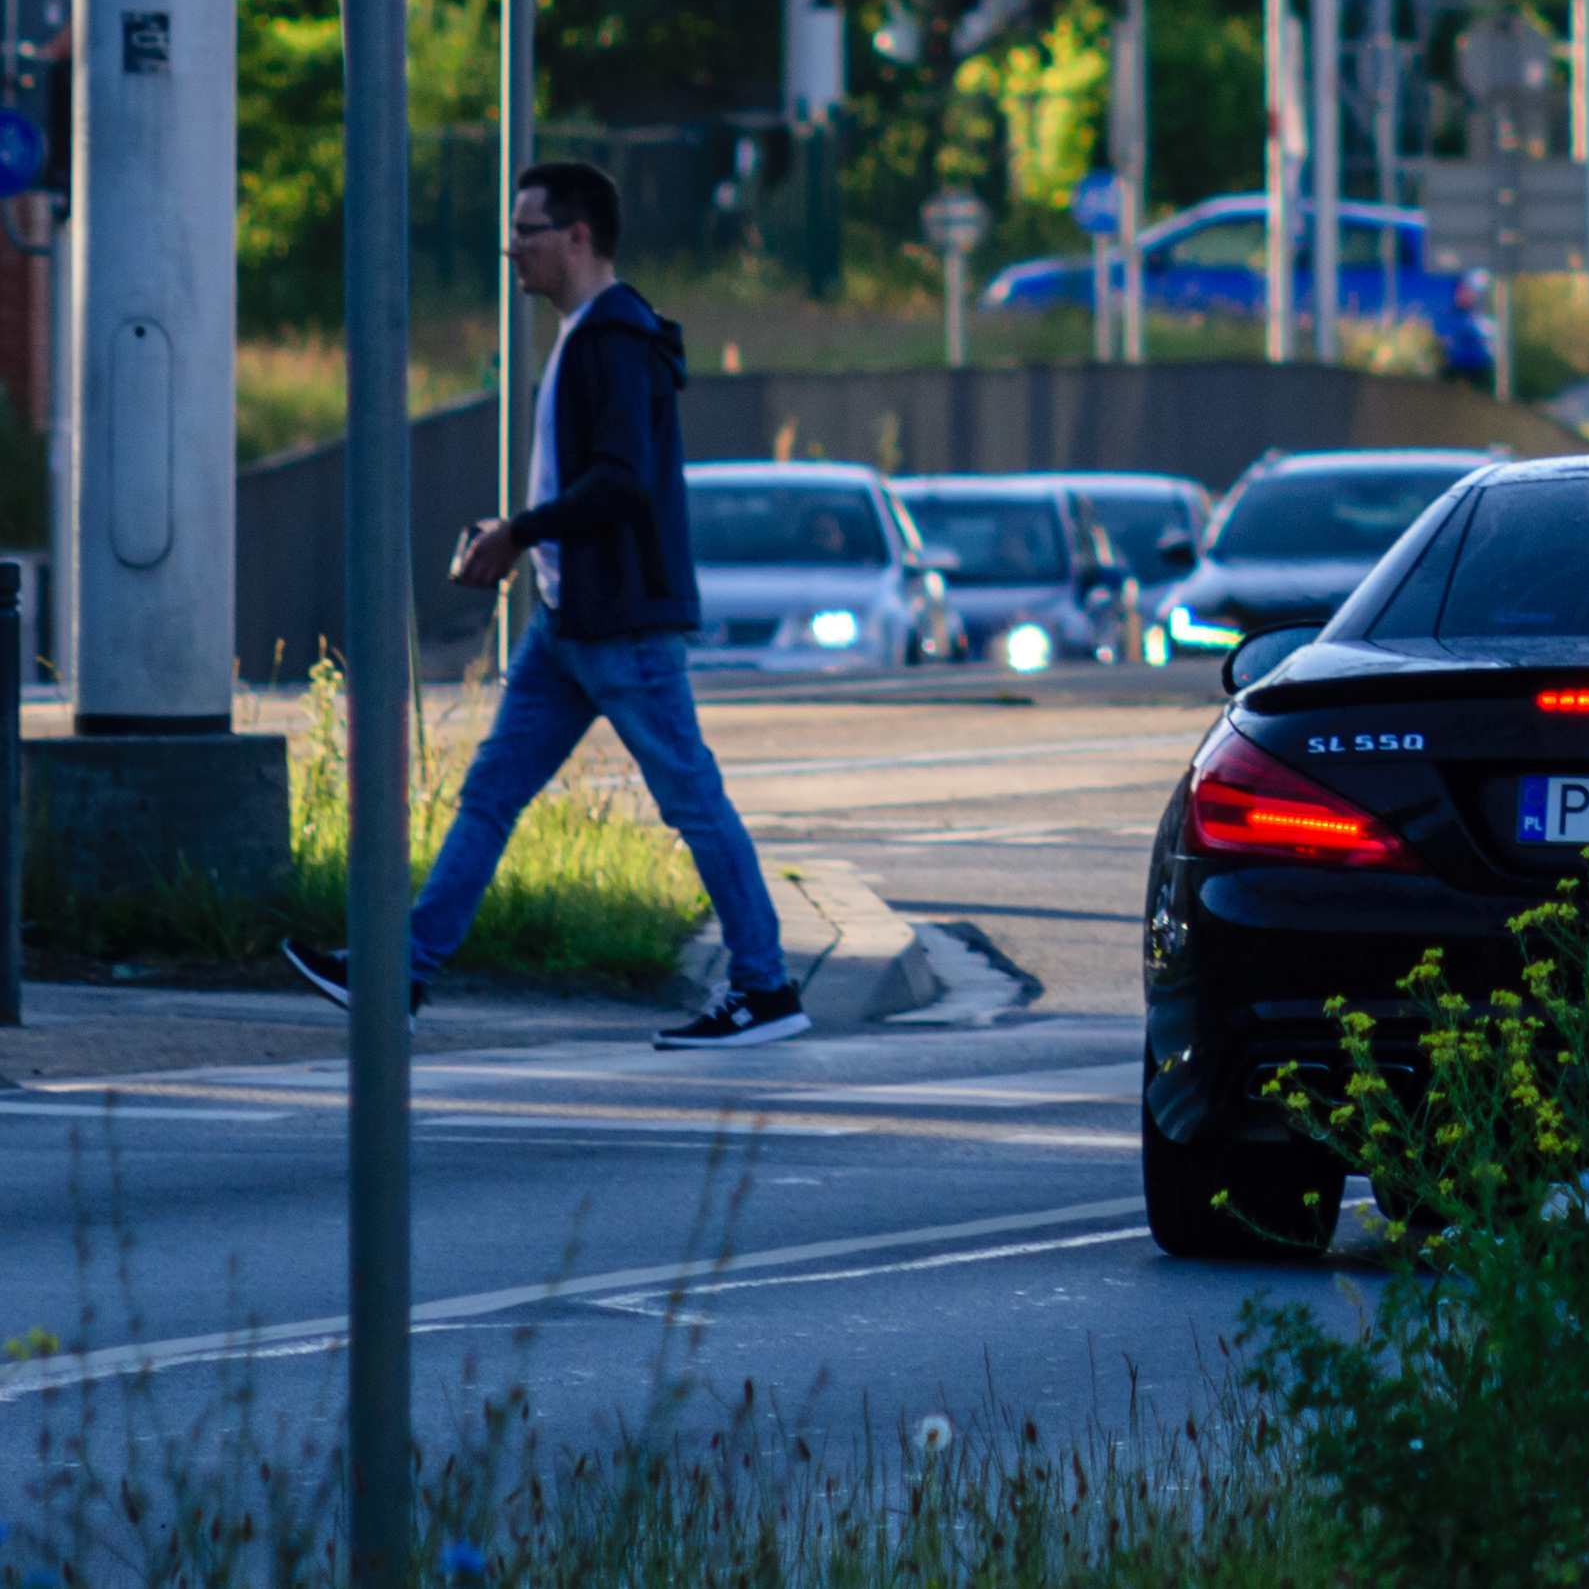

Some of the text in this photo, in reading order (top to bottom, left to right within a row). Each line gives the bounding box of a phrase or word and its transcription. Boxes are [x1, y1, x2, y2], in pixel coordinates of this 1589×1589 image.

[1307, 732, 1425, 754] SL 550
[1524, 815, 1543, 832] PL
